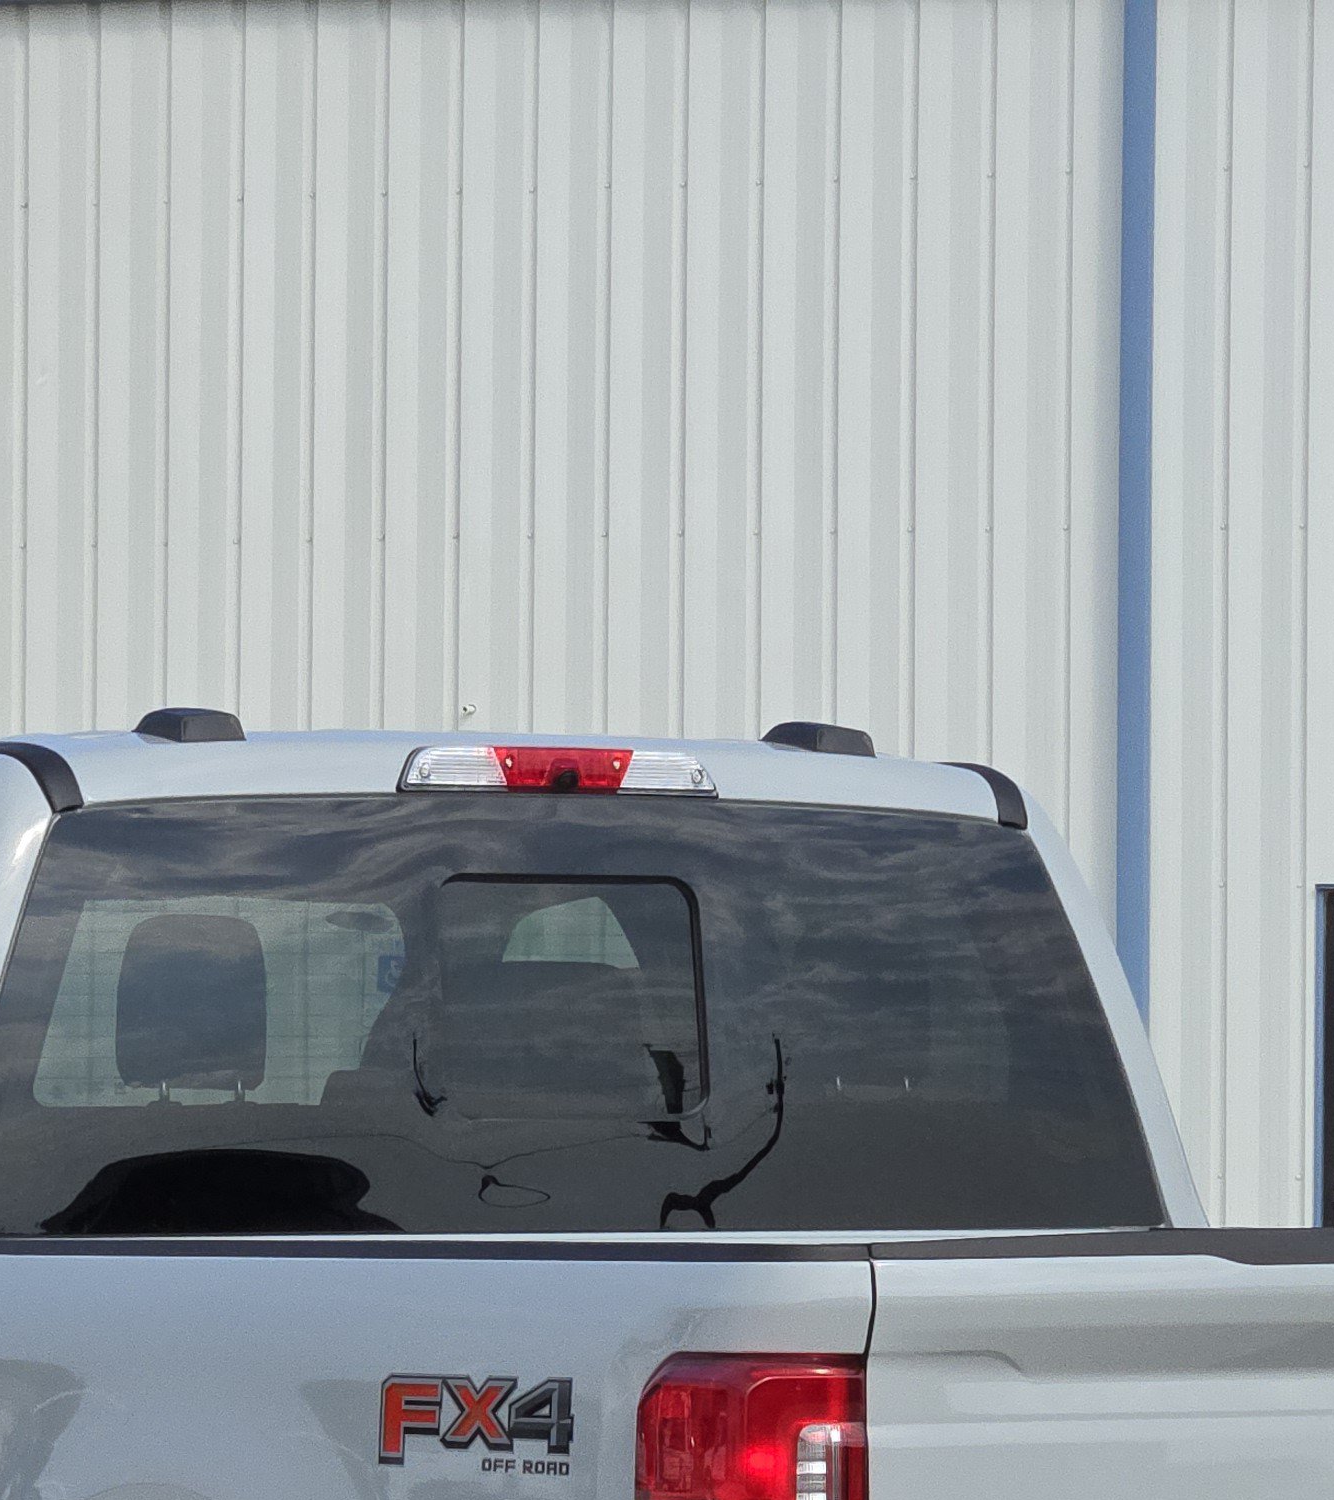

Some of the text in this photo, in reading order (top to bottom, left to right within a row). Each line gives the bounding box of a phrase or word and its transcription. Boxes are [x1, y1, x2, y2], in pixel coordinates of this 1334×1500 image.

[378, 1372, 574, 1466] FX4
[481, 1457, 570, 1476] OFF ROAD
